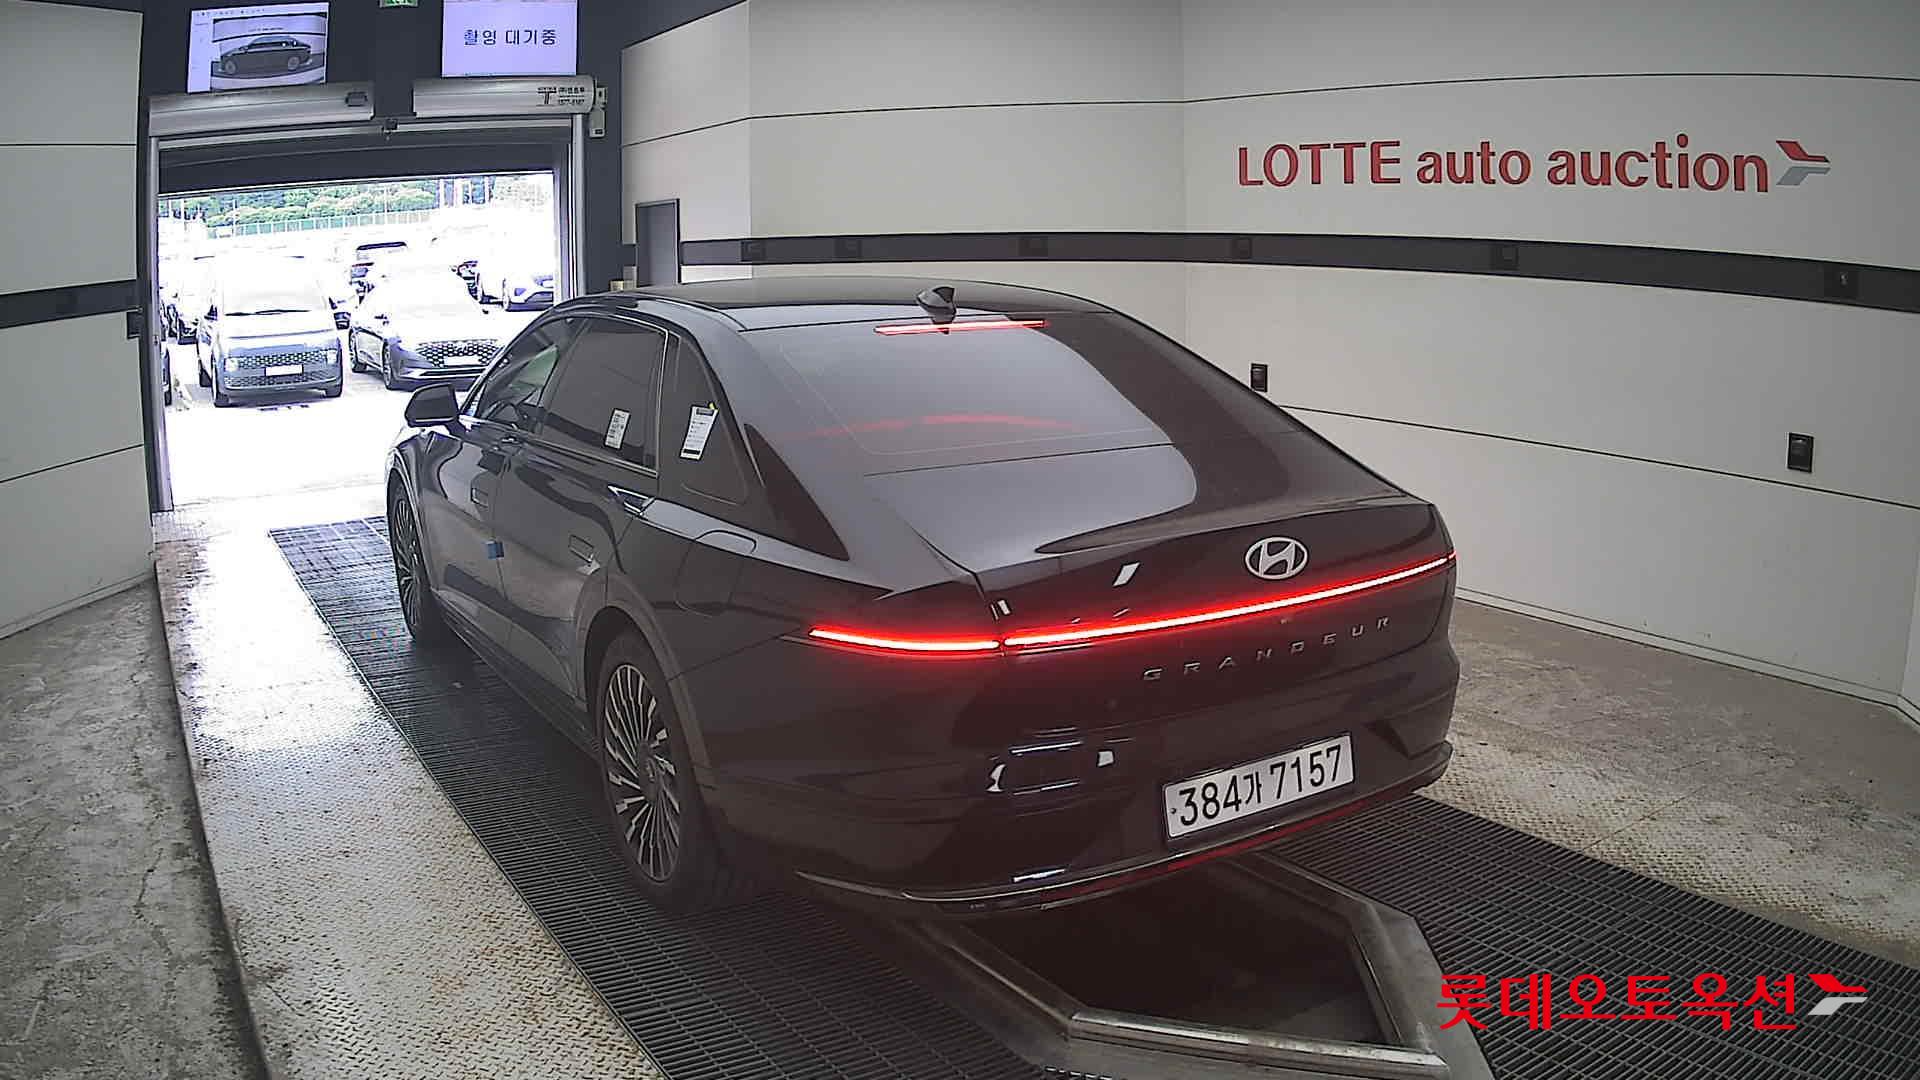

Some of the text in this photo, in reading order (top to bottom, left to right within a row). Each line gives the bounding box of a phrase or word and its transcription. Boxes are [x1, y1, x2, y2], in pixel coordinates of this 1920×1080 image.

[505, 29, 557, 46] 대기중
[1239, 134, 1769, 193] LOTTE auto auction
[1143, 617, 1390, 681] GRANDEUR
[1270, 744, 1342, 800] 7157
